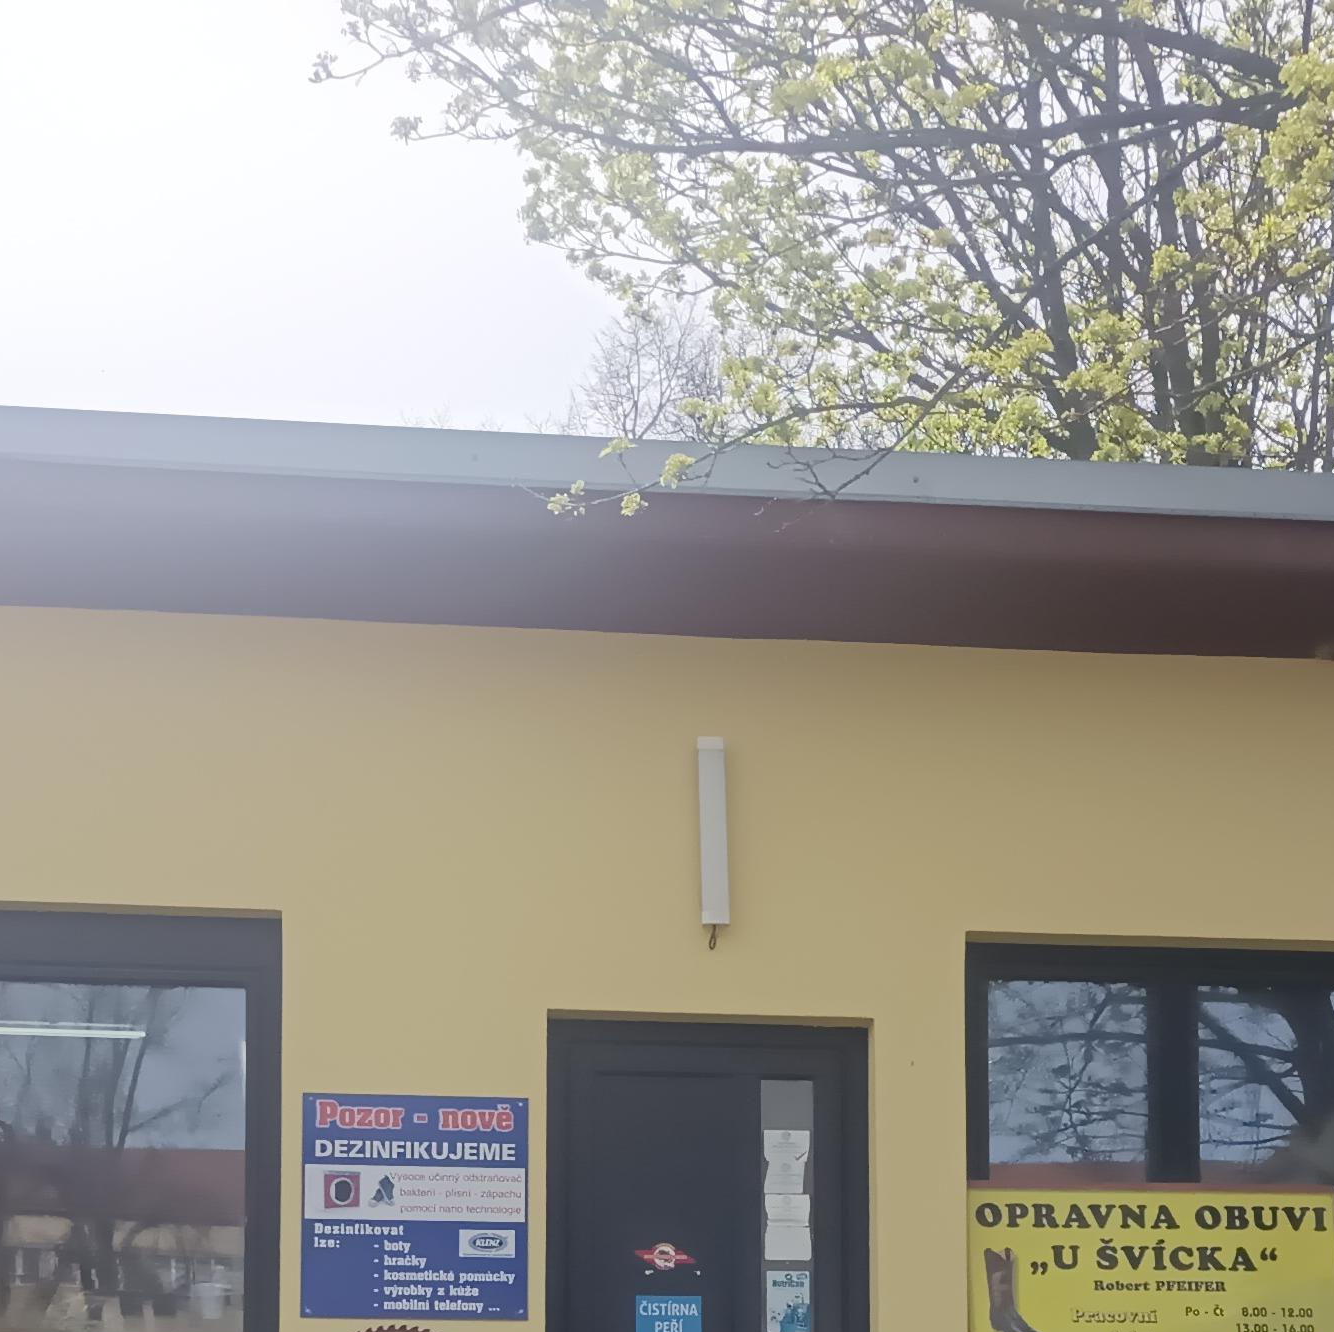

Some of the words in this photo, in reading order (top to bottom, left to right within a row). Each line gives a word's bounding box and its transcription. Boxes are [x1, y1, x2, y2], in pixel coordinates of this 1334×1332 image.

[316, 1100, 404, 1129] Pozor
[414, 1113, 428, 1123] -
[439, 1104, 514, 1132] nově
[315, 1139, 516, 1161] DEZINFIKUJEME
[480, 1190, 522, 1199] zápachu
[466, 1205, 521, 1215] technologie
[975, 1202, 1180, 1230] OPRAVNA
[1194, 1205, 1327, 1231] OBUVI
[314, 1223, 405, 1236] Dezinfikovat
[314, 1237, 340, 1248] lze:
[384, 1240, 411, 1253] boty
[384, 1255, 426, 1268] hračky
[1030, 1245, 1080, 1275] „U
[1096, 1238, 1278, 1272] ŠVÍCKA“
[384, 1270, 454, 1281] kosmetické
[459, 1270, 515, 1284] pomůcky
[384, 1284, 432, 1298] výrobky
[437, 1288, 445, 1296] z
[1094, 1280, 1149, 1292] Robert
[1155, 1281, 1226, 1292] PFEIFER
[384, 1299, 429, 1310] mobilní
[434, 1300, 483, 1313] telefony
[639, 1300, 698, 1316] ČISTÍRNA
[1185, 1306, 1199, 1316] Po
[1213, 1304, 1224, 1316] Čt
[1242, 1307, 1267, 1317] 8.00
[1281, 1307, 1313, 1318] 12.00
[1072, 1309, 1158, 1323] Pracovní
